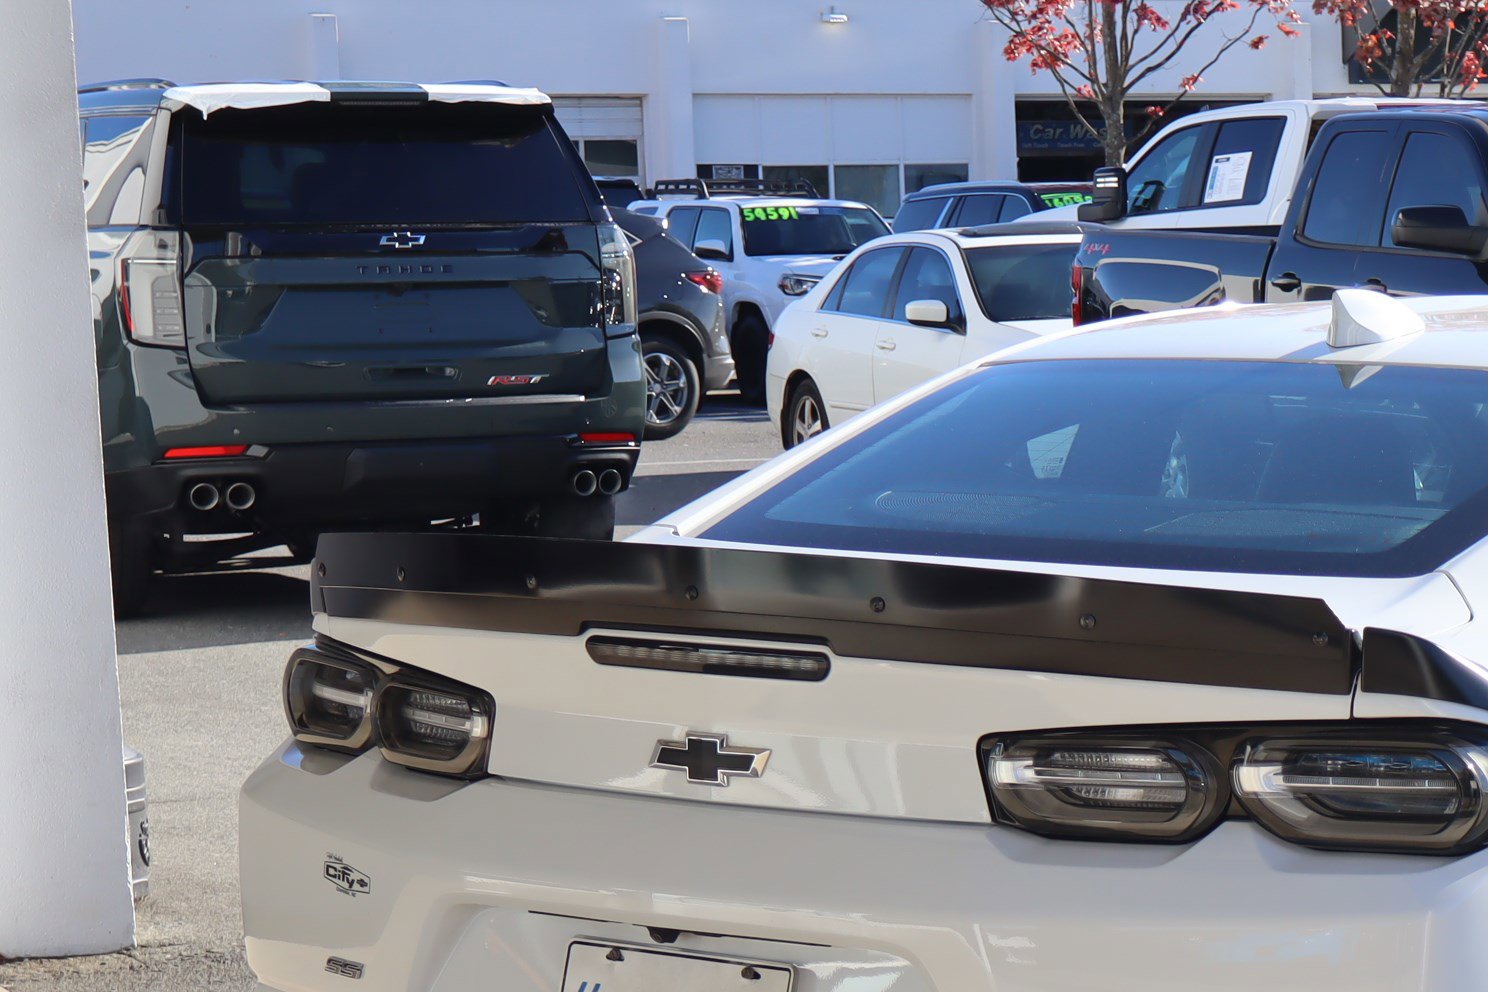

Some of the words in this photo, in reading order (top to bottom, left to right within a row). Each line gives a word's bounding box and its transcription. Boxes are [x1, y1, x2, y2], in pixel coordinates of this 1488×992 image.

[1029, 124, 1063, 140] Car
[1070, 124, 1108, 140] Was
[356, 264, 453, 275] TAHOE
[487, 373, 550, 386] RST
[324, 956, 364, 979] SS
